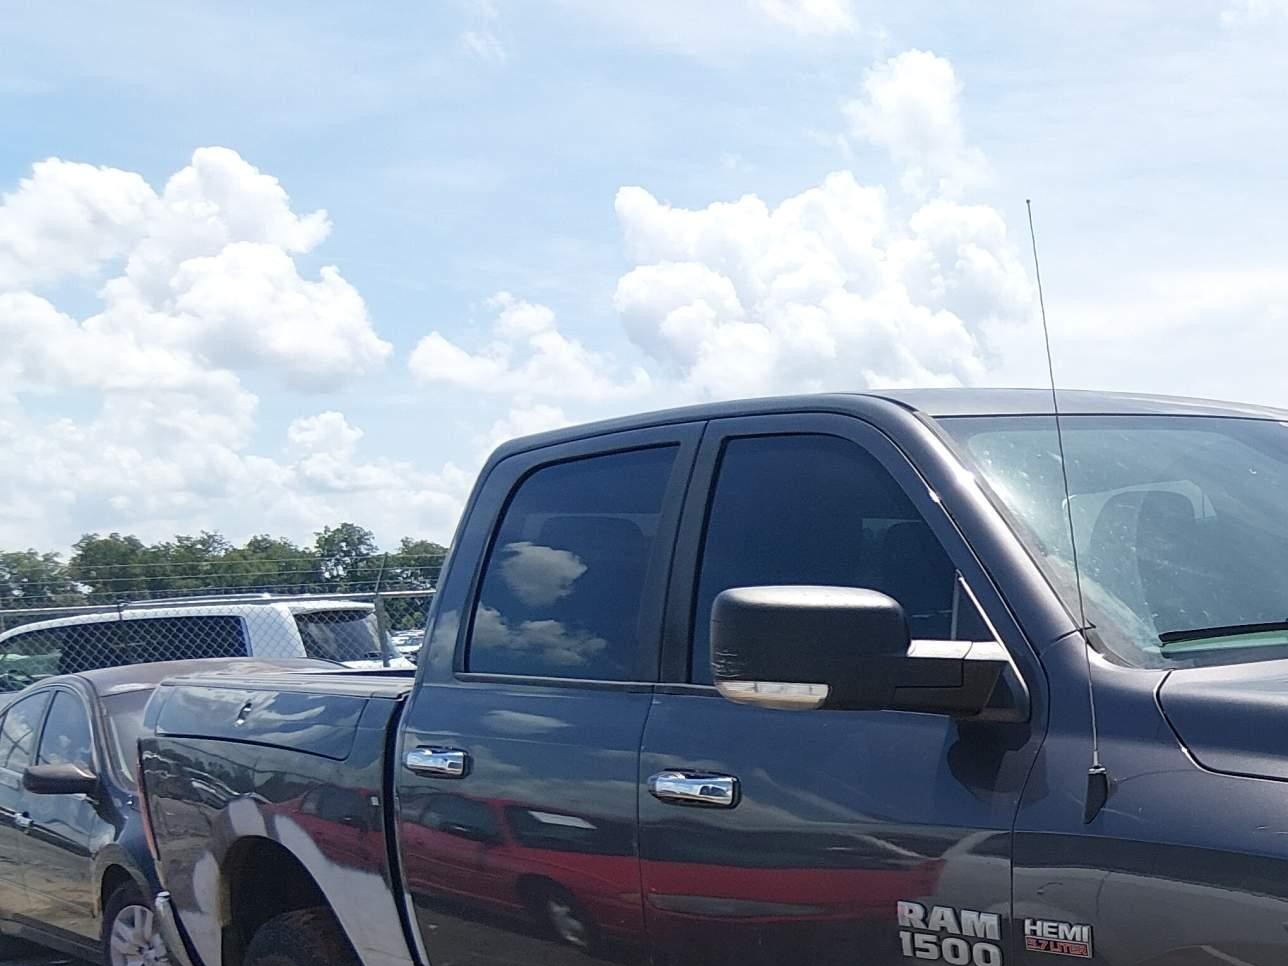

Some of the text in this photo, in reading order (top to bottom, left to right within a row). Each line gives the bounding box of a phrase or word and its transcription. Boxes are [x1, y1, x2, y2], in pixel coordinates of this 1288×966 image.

[897, 901, 1000, 940] RAM
[1024, 918, 1089, 942] HEMI
[1049, 941, 1088, 956] LITER
